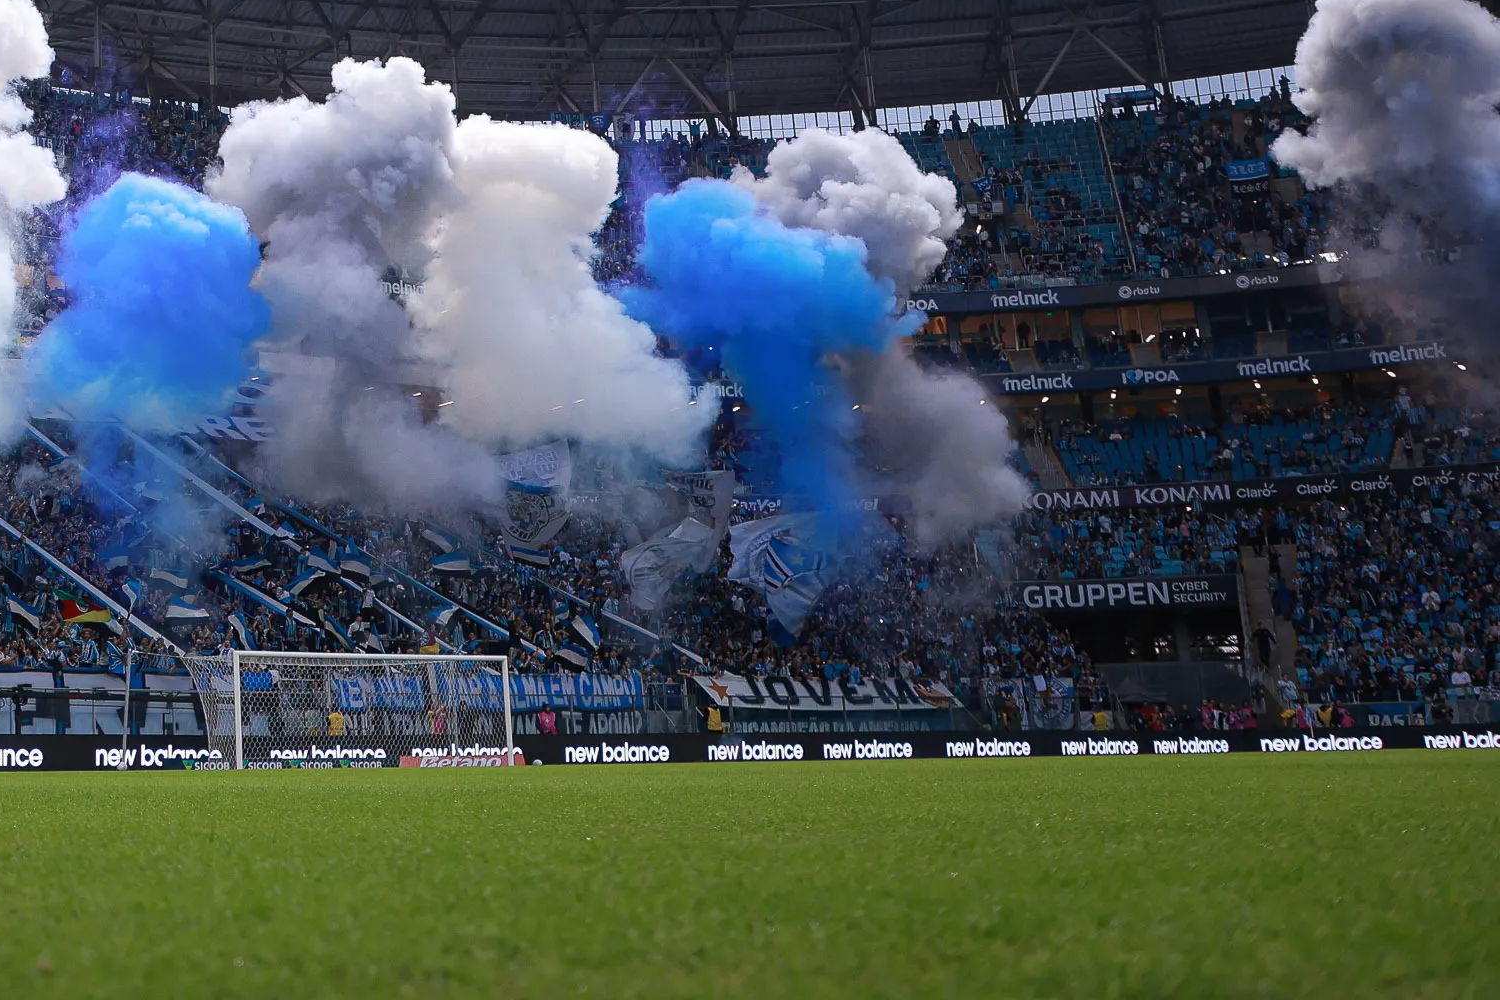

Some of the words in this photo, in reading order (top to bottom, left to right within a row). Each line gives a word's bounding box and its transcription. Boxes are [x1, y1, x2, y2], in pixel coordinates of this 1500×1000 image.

[906, 299, 939, 311] POA
[991, 290, 1060, 308] melnick
[1369, 342, 1447, 365] melnick
[1237, 356, 1312, 376] melnick
[1002, 374, 1073, 392] melnick
[1144, 369, 1179, 383] POA
[1237, 483, 1275, 498] Claro
[1297, 479, 1335, 494] Claro
[1351, 476, 1390, 491] Claro
[1135, 484, 1232, 505] KONAMI
[1023, 582, 1169, 608] GRUPPEN
[1172, 581, 1209, 592] CYBER
[1173, 592, 1227, 603] SECURITY
[736, 677, 922, 706] JOVEM
[707, 743, 739, 761] new
[741, 740, 803, 760] balance
[823, 742, 853, 759] new
[854, 739, 913, 758] balance
[946, 740, 975, 757] new
[975, 738, 1031, 757] balance
[1061, 740, 1087, 755] new
[1088, 737, 1139, 755] balance
[1154, 739, 1178, 754] new
[1177, 736, 1229, 753] balance
[1260, 737, 1300, 752] new
[1303, 733, 1382, 751] balance
[1424, 734, 1461, 749] new
[95, 747, 137, 768] new
[565, 745, 599, 763] new
[602, 742, 670, 763] balance
